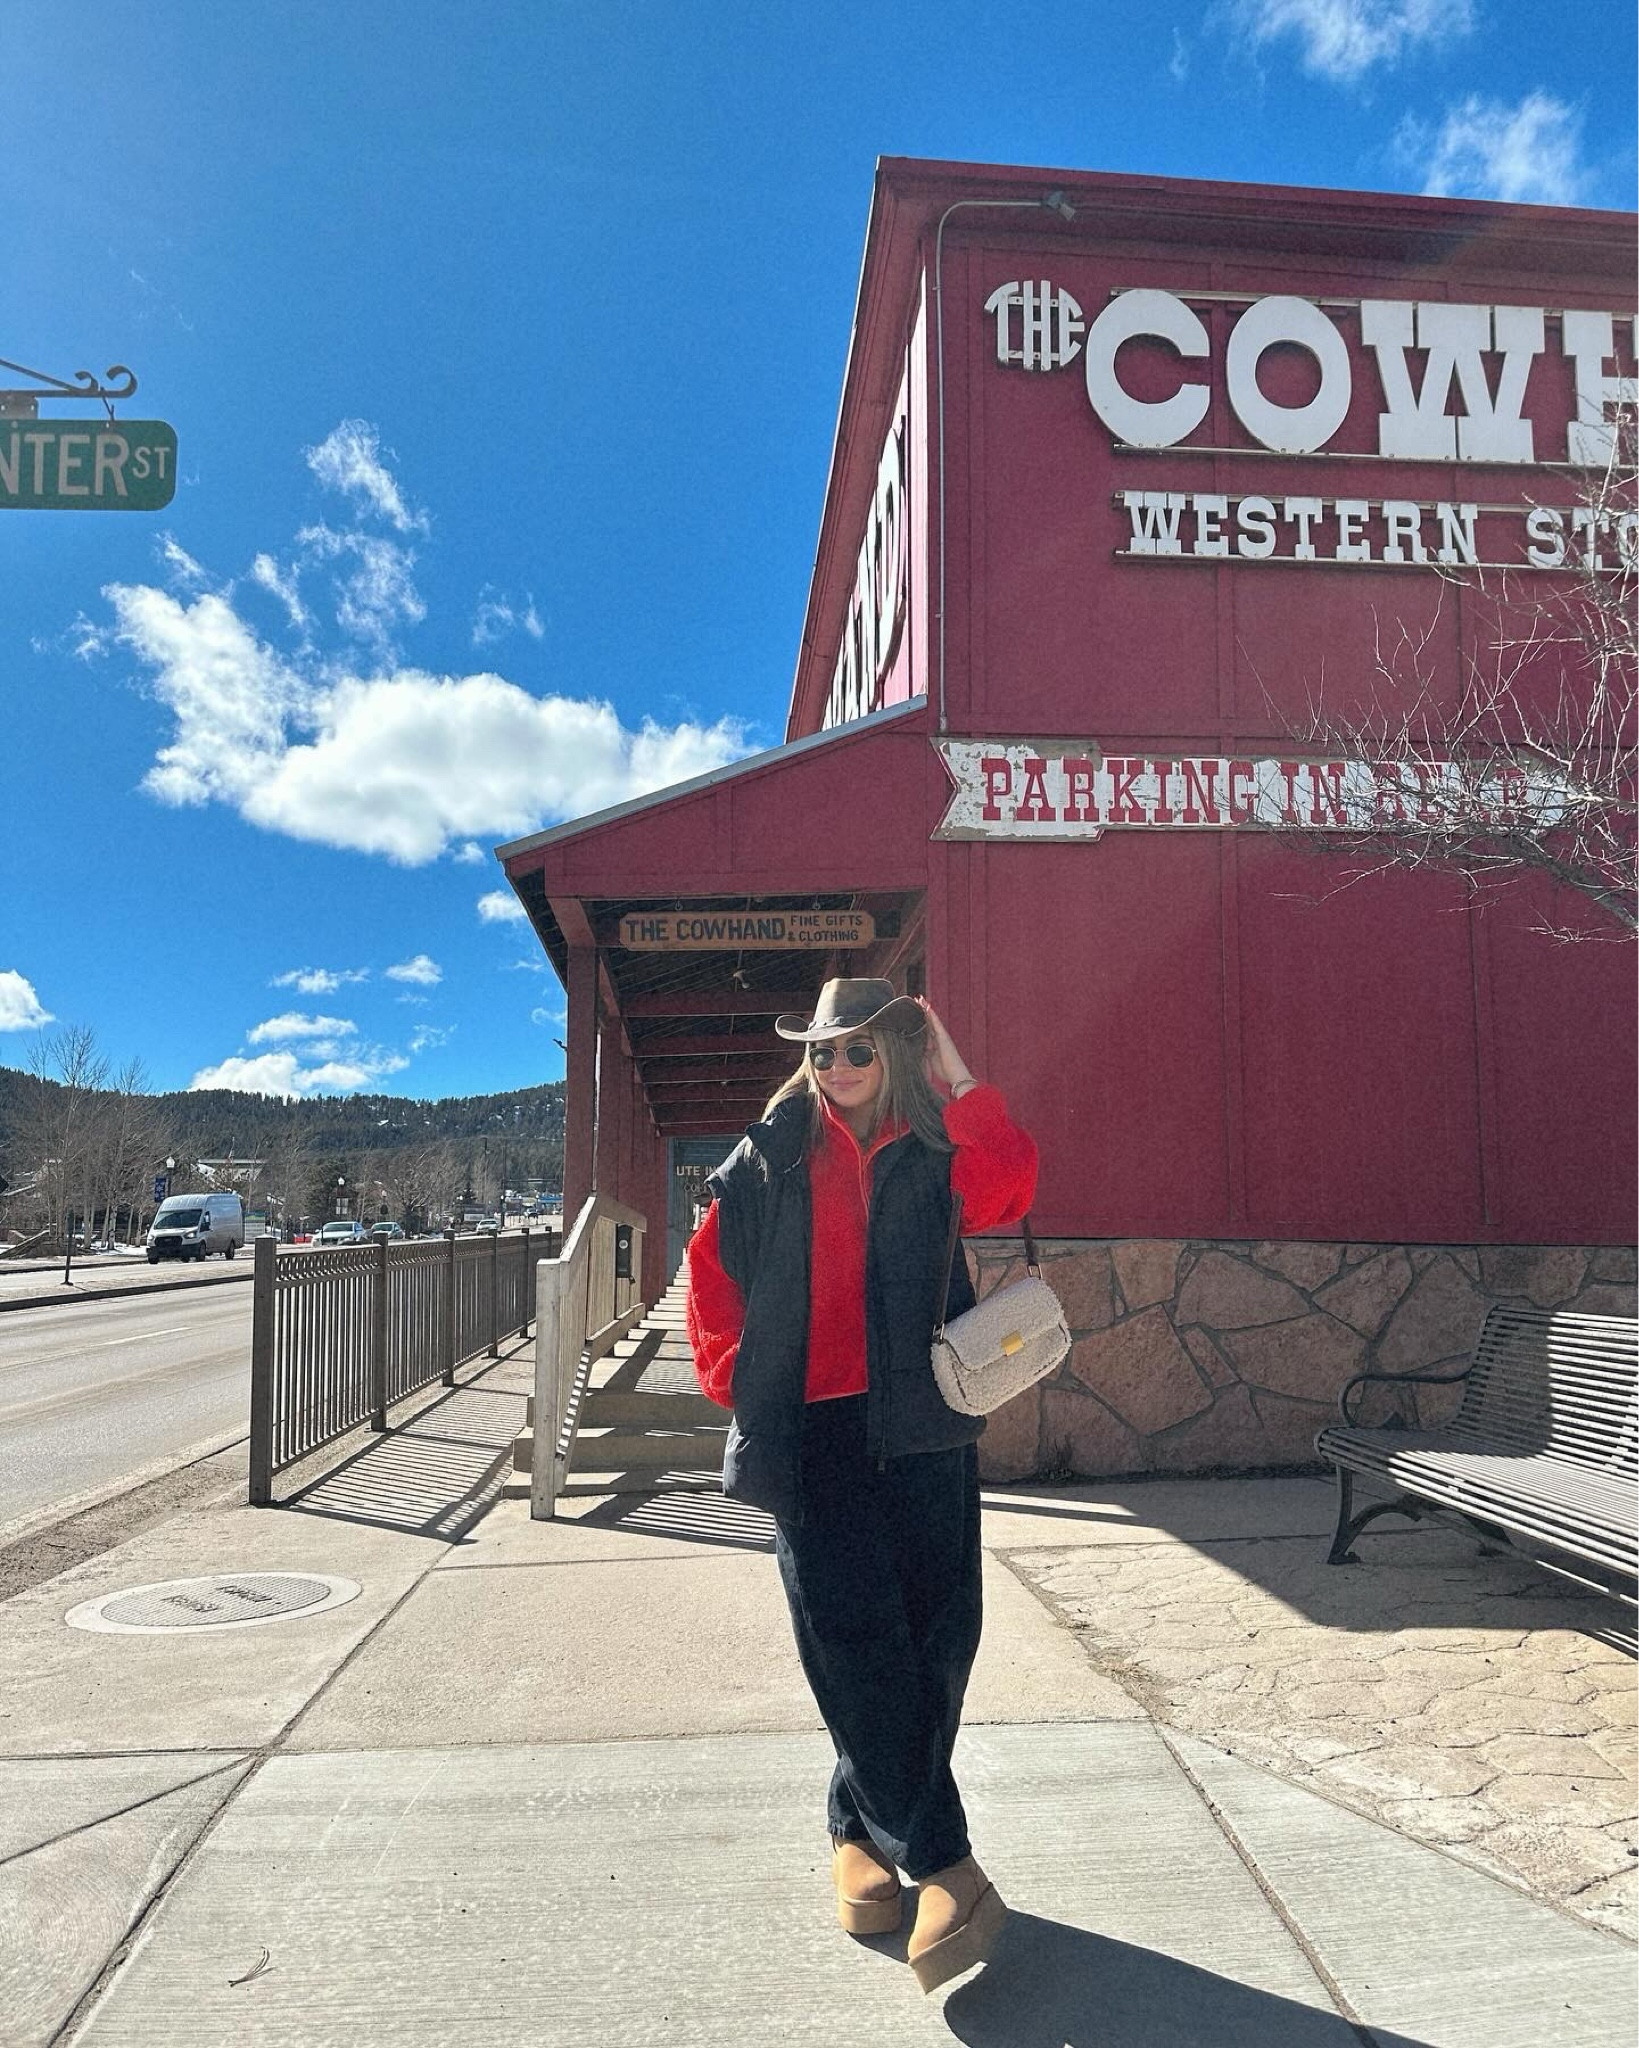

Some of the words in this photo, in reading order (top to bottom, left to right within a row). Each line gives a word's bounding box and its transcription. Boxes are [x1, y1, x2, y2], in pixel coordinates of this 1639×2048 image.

[984, 280, 1085, 371] THE
[132, 446, 170, 480] ST
[1123, 491, 1479, 565] WESTERN
[981, 757, 1259, 824] PARKING
[1280, 760, 1348, 825] IN
[626, 919, 670, 942] THE
[676, 917, 786, 941] COWHAND
[790, 915, 820, 926] FINE
[826, 915, 862, 926] GIFTS
[788, 931, 796, 941] &
[799, 930, 859, 941] CLOTHING
[676, 1165, 700, 1176] UTE
